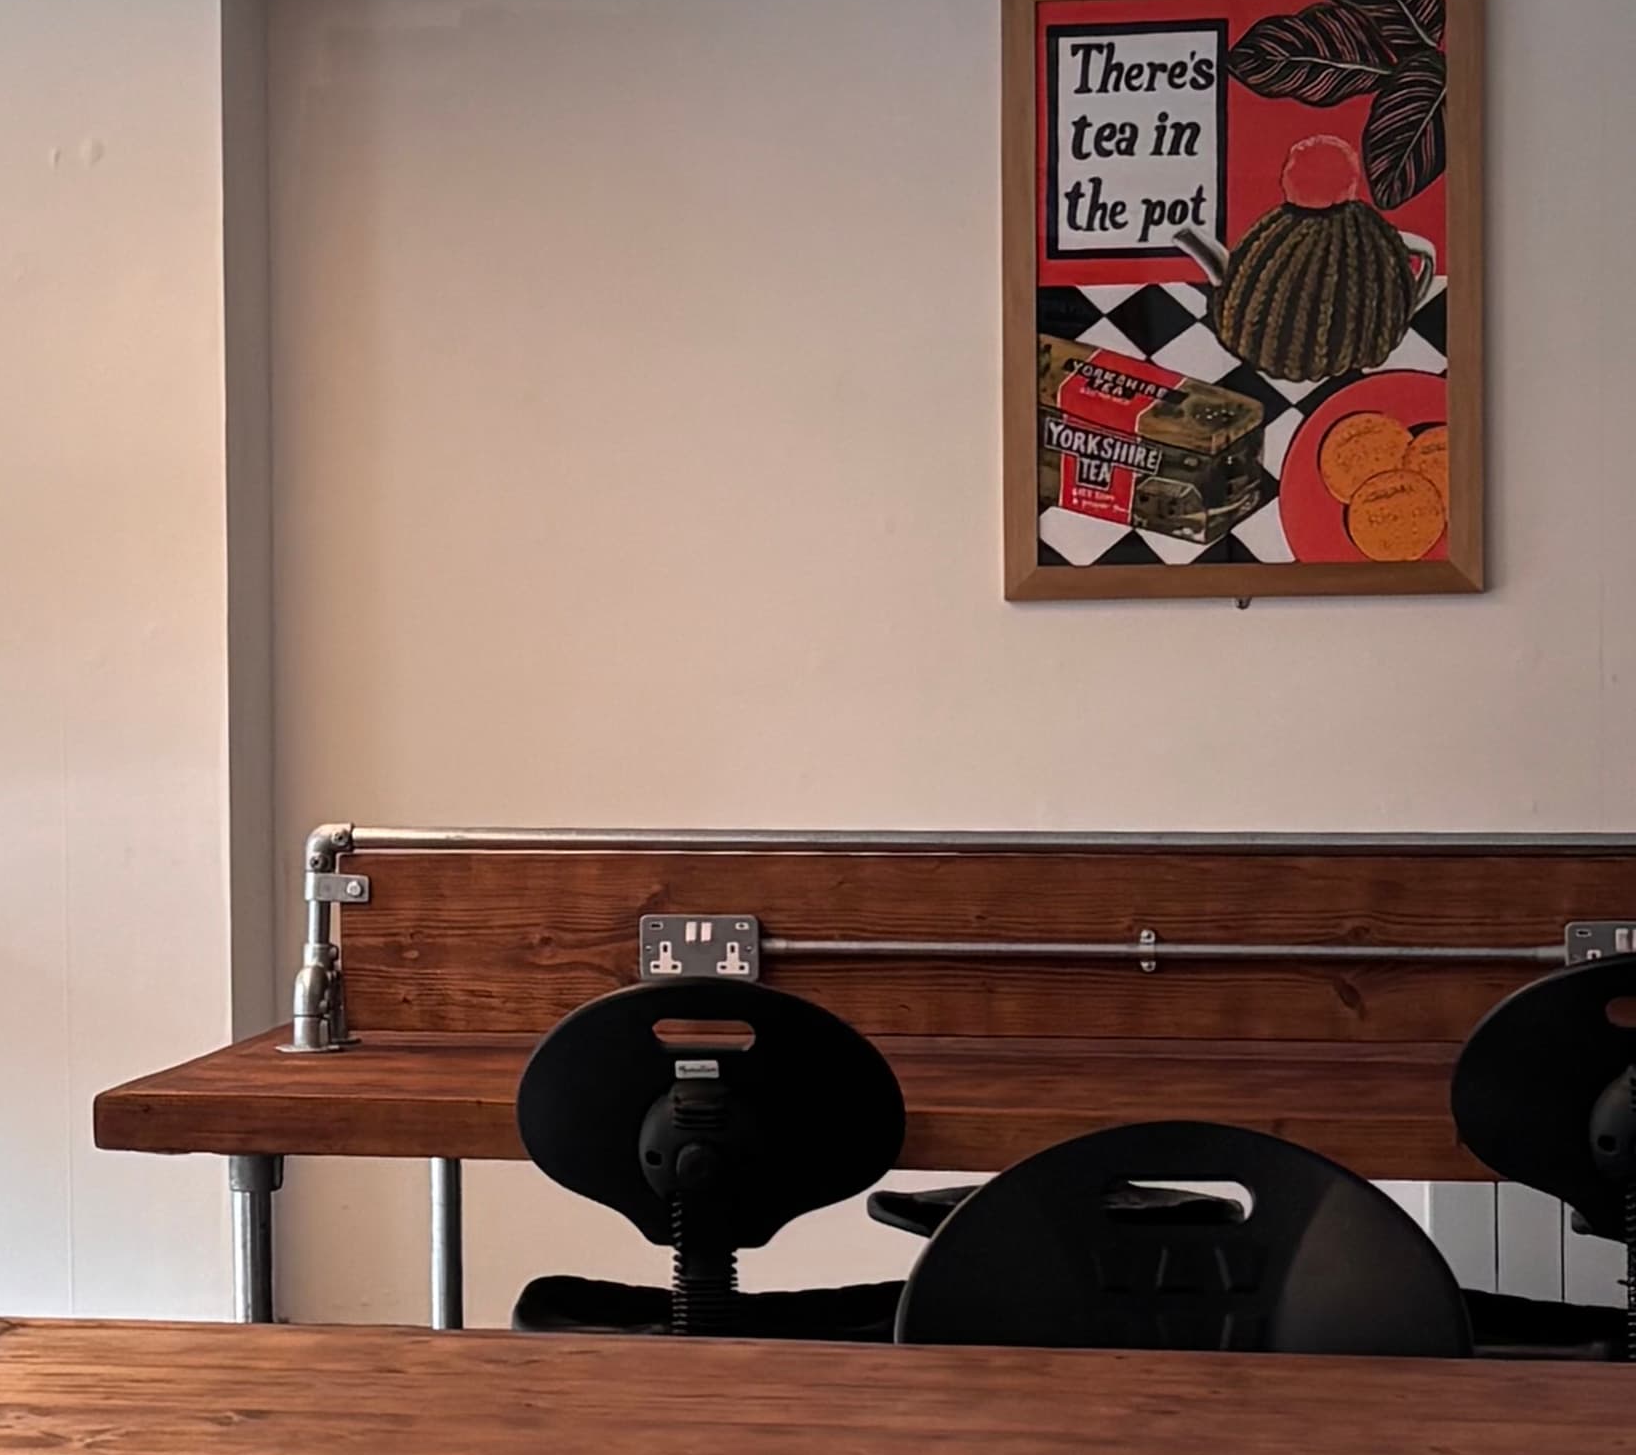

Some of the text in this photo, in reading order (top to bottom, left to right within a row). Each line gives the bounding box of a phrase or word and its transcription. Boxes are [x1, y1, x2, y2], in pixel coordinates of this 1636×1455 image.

[1070, 42, 1215, 95] There's
[1070, 111, 1201, 161] tea in
[1064, 176, 1207, 243] the pot
[1072, 360, 1167, 399] YORKSHIRE
[1092, 378, 1124, 396] TEA
[1049, 421, 1158, 470] YORKSHIRE
[1080, 457, 1111, 483] TEA
